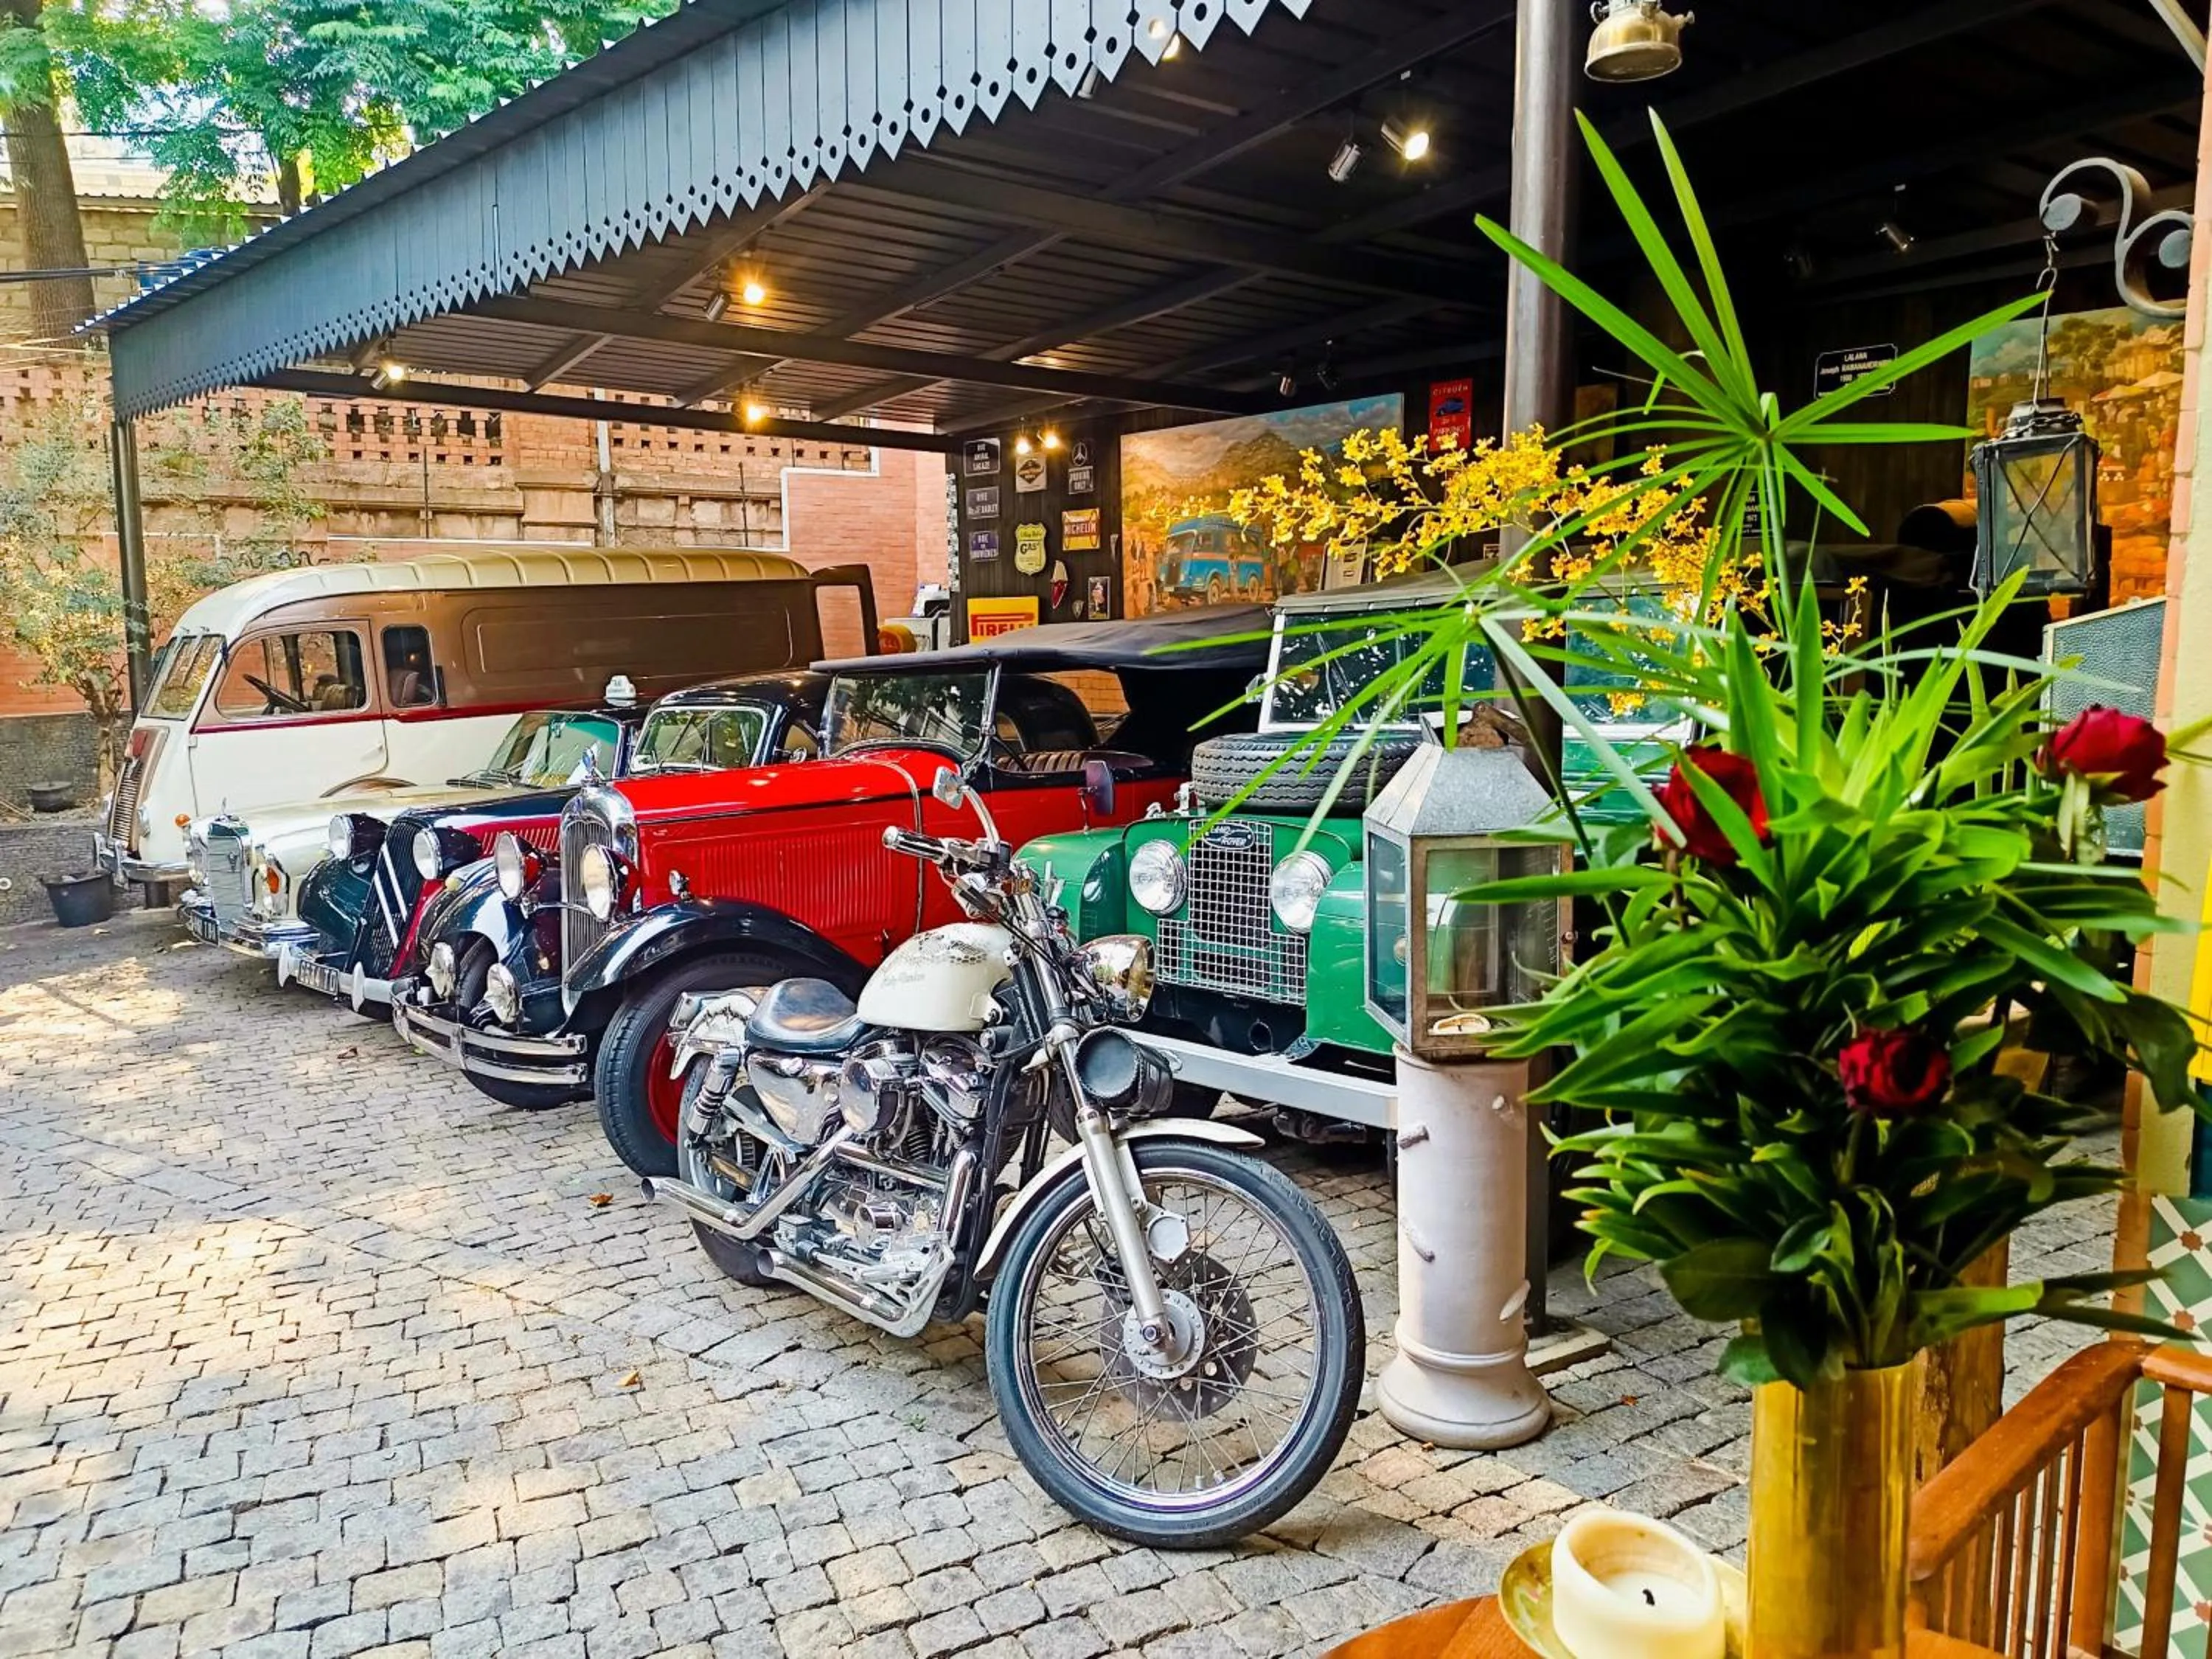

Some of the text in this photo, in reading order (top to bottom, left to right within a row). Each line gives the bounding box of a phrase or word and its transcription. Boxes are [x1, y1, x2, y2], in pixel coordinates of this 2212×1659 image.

[1844, 352, 1868, 361] LALANA
[1064, 522, 1097, 535] MICHELIN
[1020, 542, 1037, 555] GAS
[1210, 824, 1231, 835] LAND
[1220, 836, 1248, 847] ROVER
